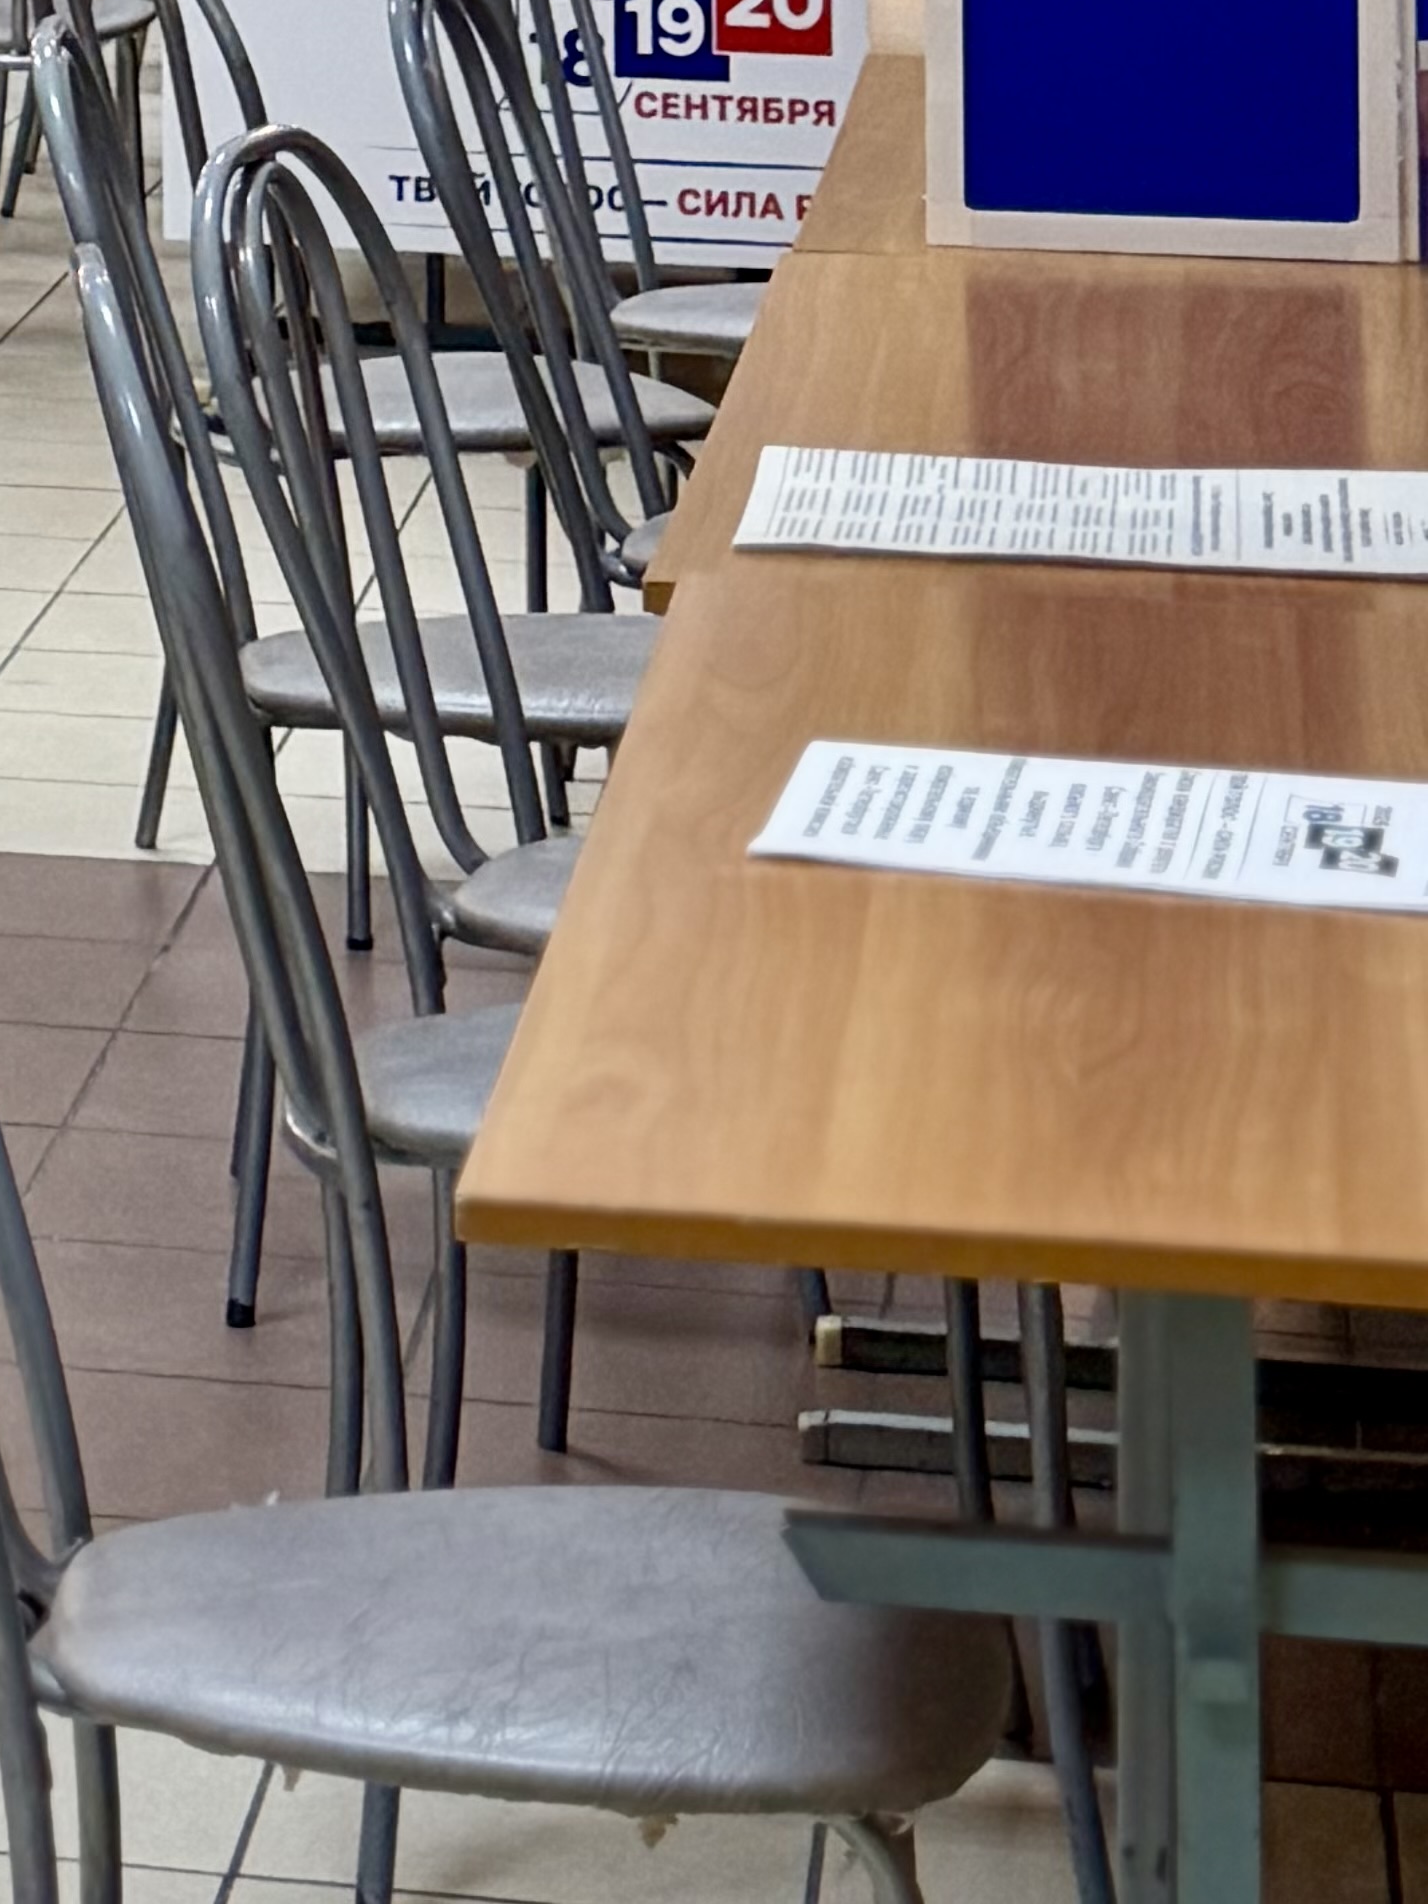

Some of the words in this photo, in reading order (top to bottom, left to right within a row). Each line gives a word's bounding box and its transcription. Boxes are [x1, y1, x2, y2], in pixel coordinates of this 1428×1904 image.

[634, 90, 836, 127] СЕНТЯБРЯ
[388, 172, 491, 206] ТВЙ
[677, 188, 785, 220] СИЛА
[1302, 804, 1344, 823] 18
[1321, 828, 1364, 849] 19
[1338, 849, 1382, 872] 20
